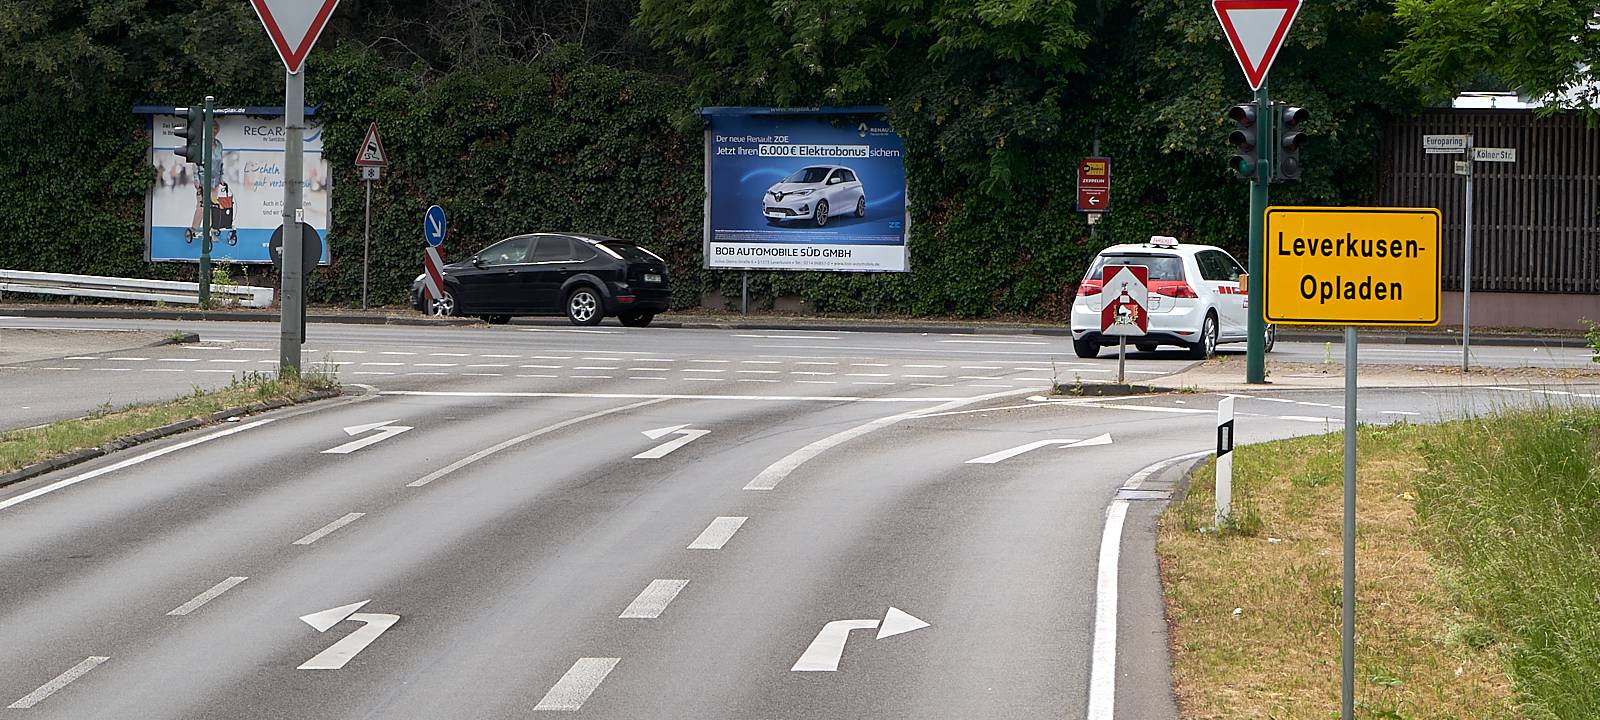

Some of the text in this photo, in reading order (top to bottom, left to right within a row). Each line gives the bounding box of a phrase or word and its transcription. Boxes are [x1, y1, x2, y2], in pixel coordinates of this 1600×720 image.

[716, 135, 727, 143] Der
[747, 135, 773, 143] Renault
[774, 135, 789, 143] ZOE
[1426, 136, 1463, 147] Europaring
[716, 145, 900, 157] Jetzt Ihren 6.000 € Elektrobonus sichern
[1477, 149, 1513, 160] Kölner Str.
[1278, 231, 1426, 258] Leverkusen-
[715, 246, 852, 258] BOB AUTOMOBILE SÜD GMBH
[1300, 274, 1403, 305] Opladen
